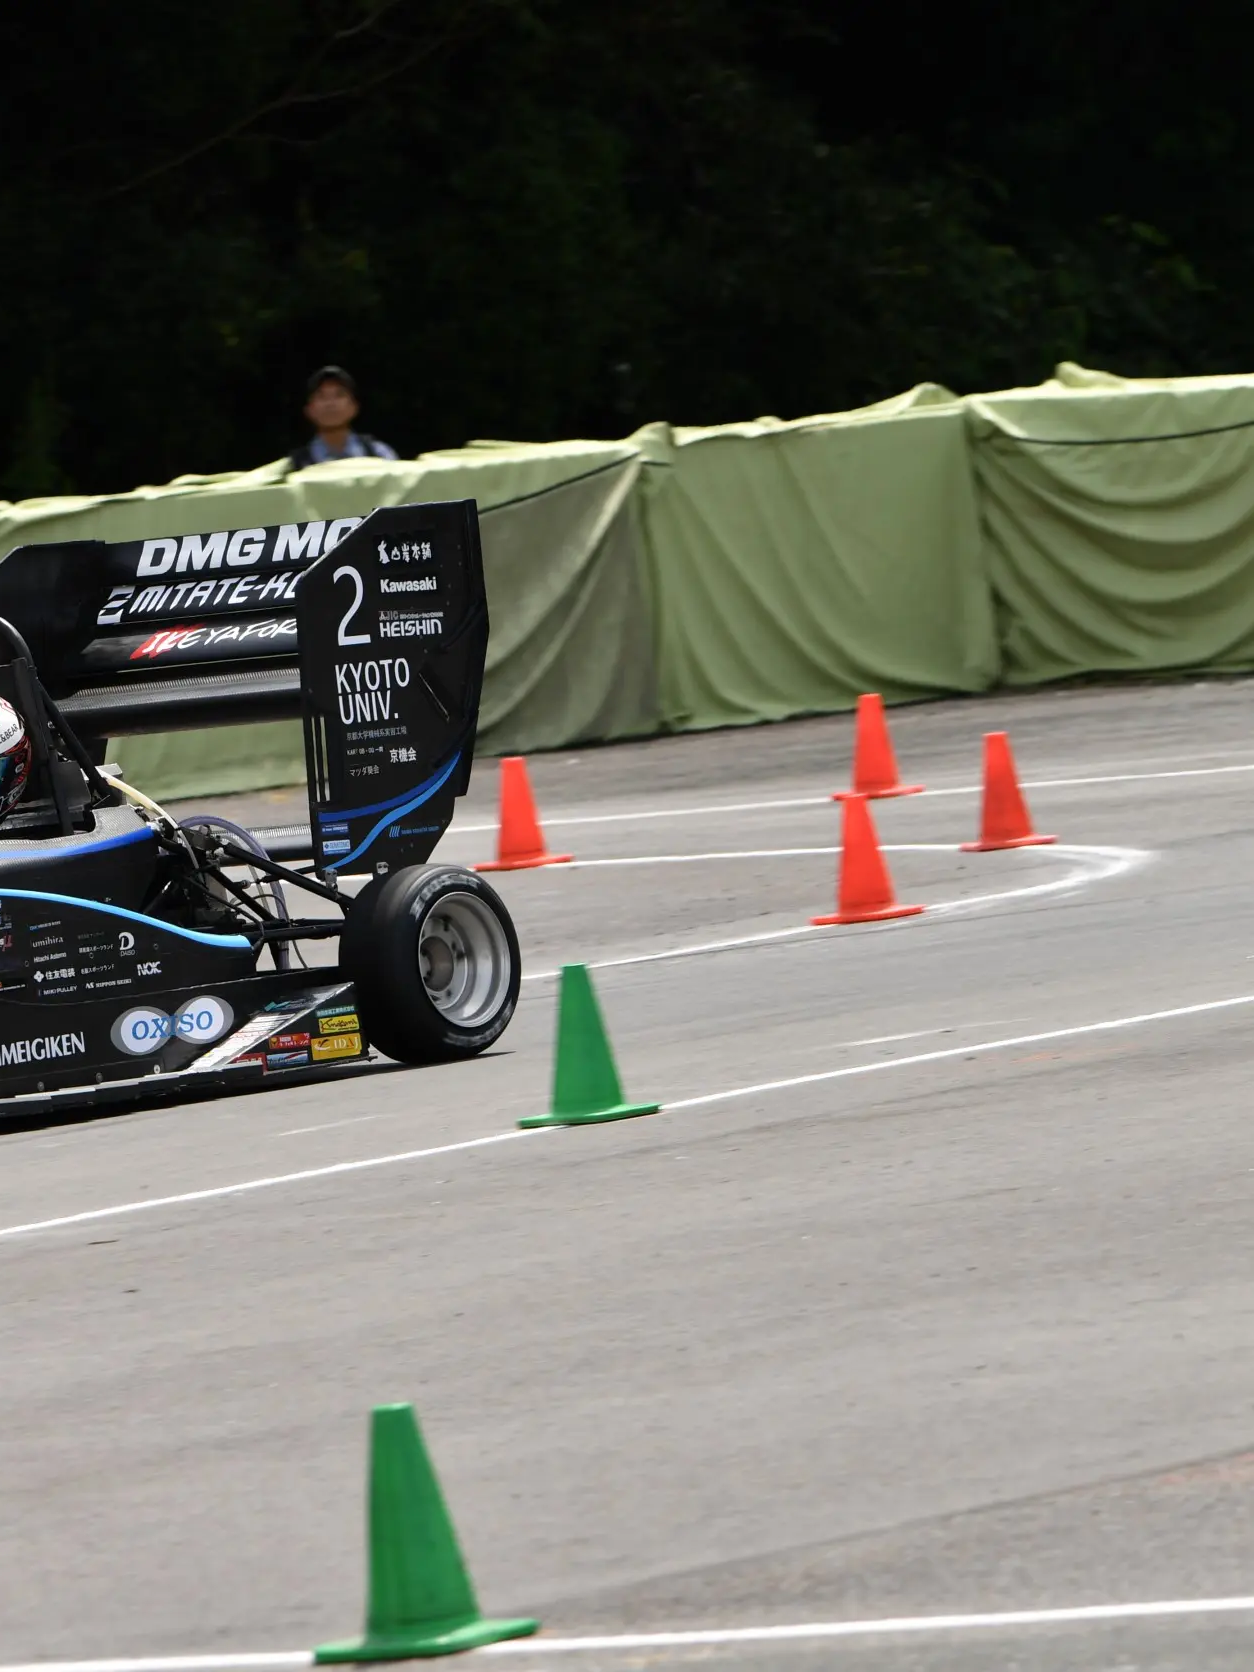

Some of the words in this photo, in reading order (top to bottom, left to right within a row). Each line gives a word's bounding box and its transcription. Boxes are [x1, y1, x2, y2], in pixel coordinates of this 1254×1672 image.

[136, 527, 266, 577] DMG
[272, 517, 364, 561] MO
[379, 576, 437, 593] Kawasaki
[333, 565, 371, 646] 2
[379, 618, 443, 638] HEISHIN
[335, 657, 410, 694] KYOTO
[338, 689, 399, 725] UNIV.
[389, 746, 417, 763] 京機会
[137, 961, 162, 977] NOK
[132, 1010, 214, 1041] OXISO
